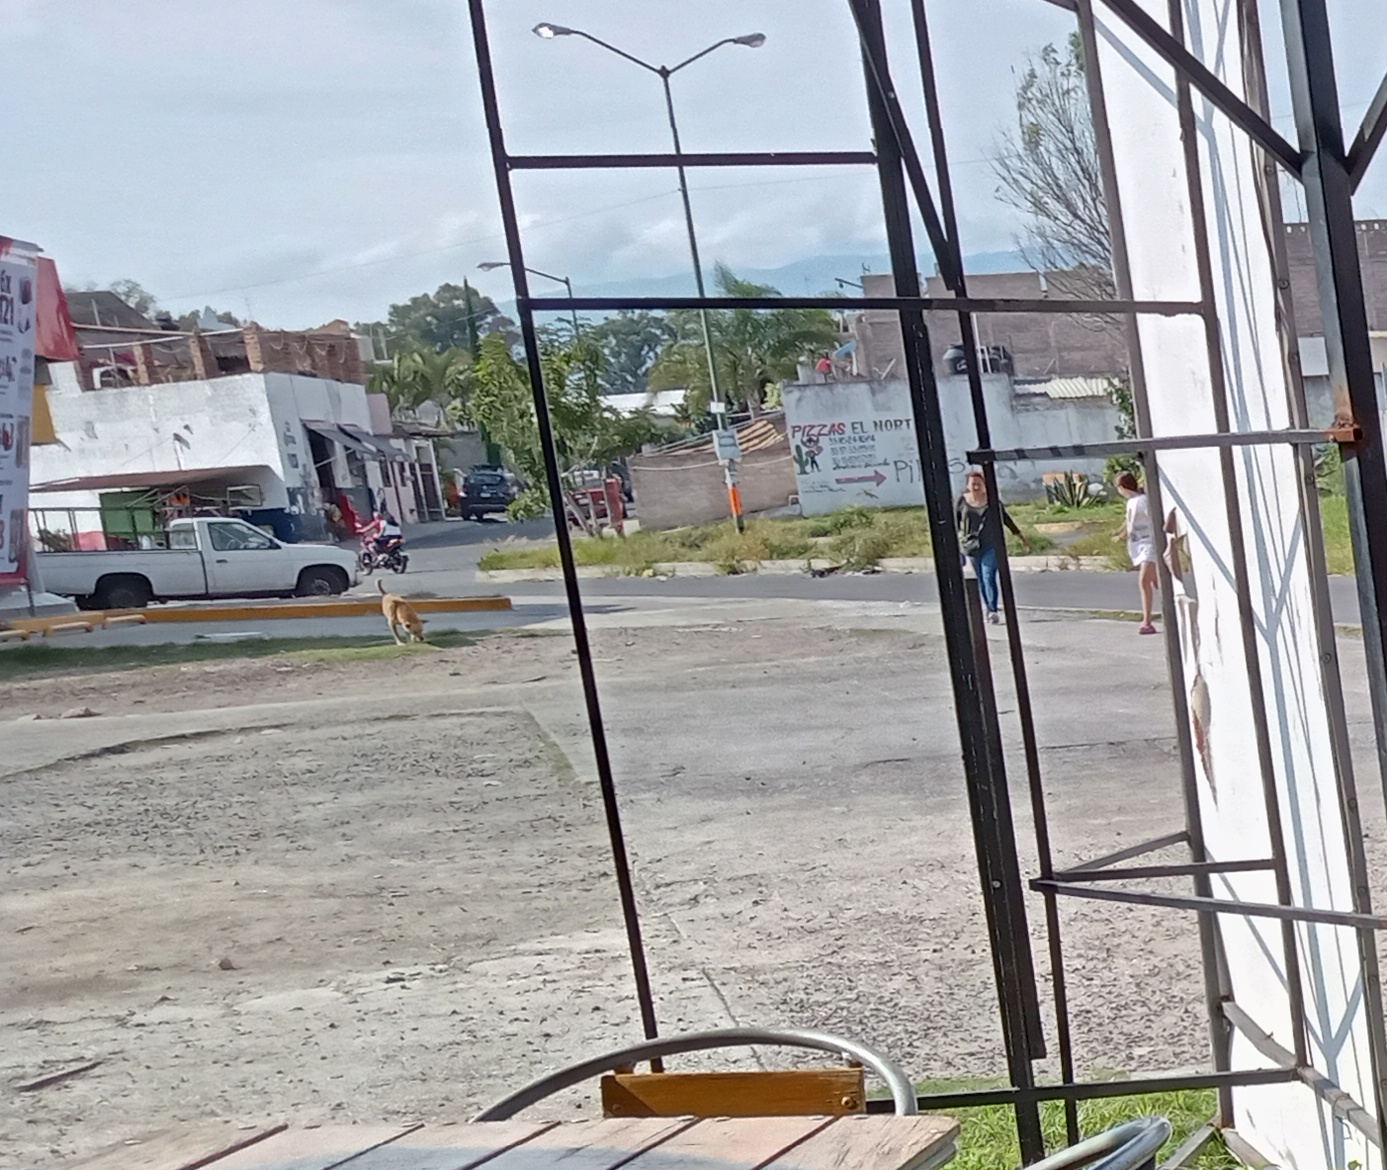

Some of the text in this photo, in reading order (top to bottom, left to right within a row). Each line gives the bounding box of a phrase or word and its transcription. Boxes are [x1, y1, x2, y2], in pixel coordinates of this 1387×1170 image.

[791, 418, 912, 439] PIZZAS EL NORT
